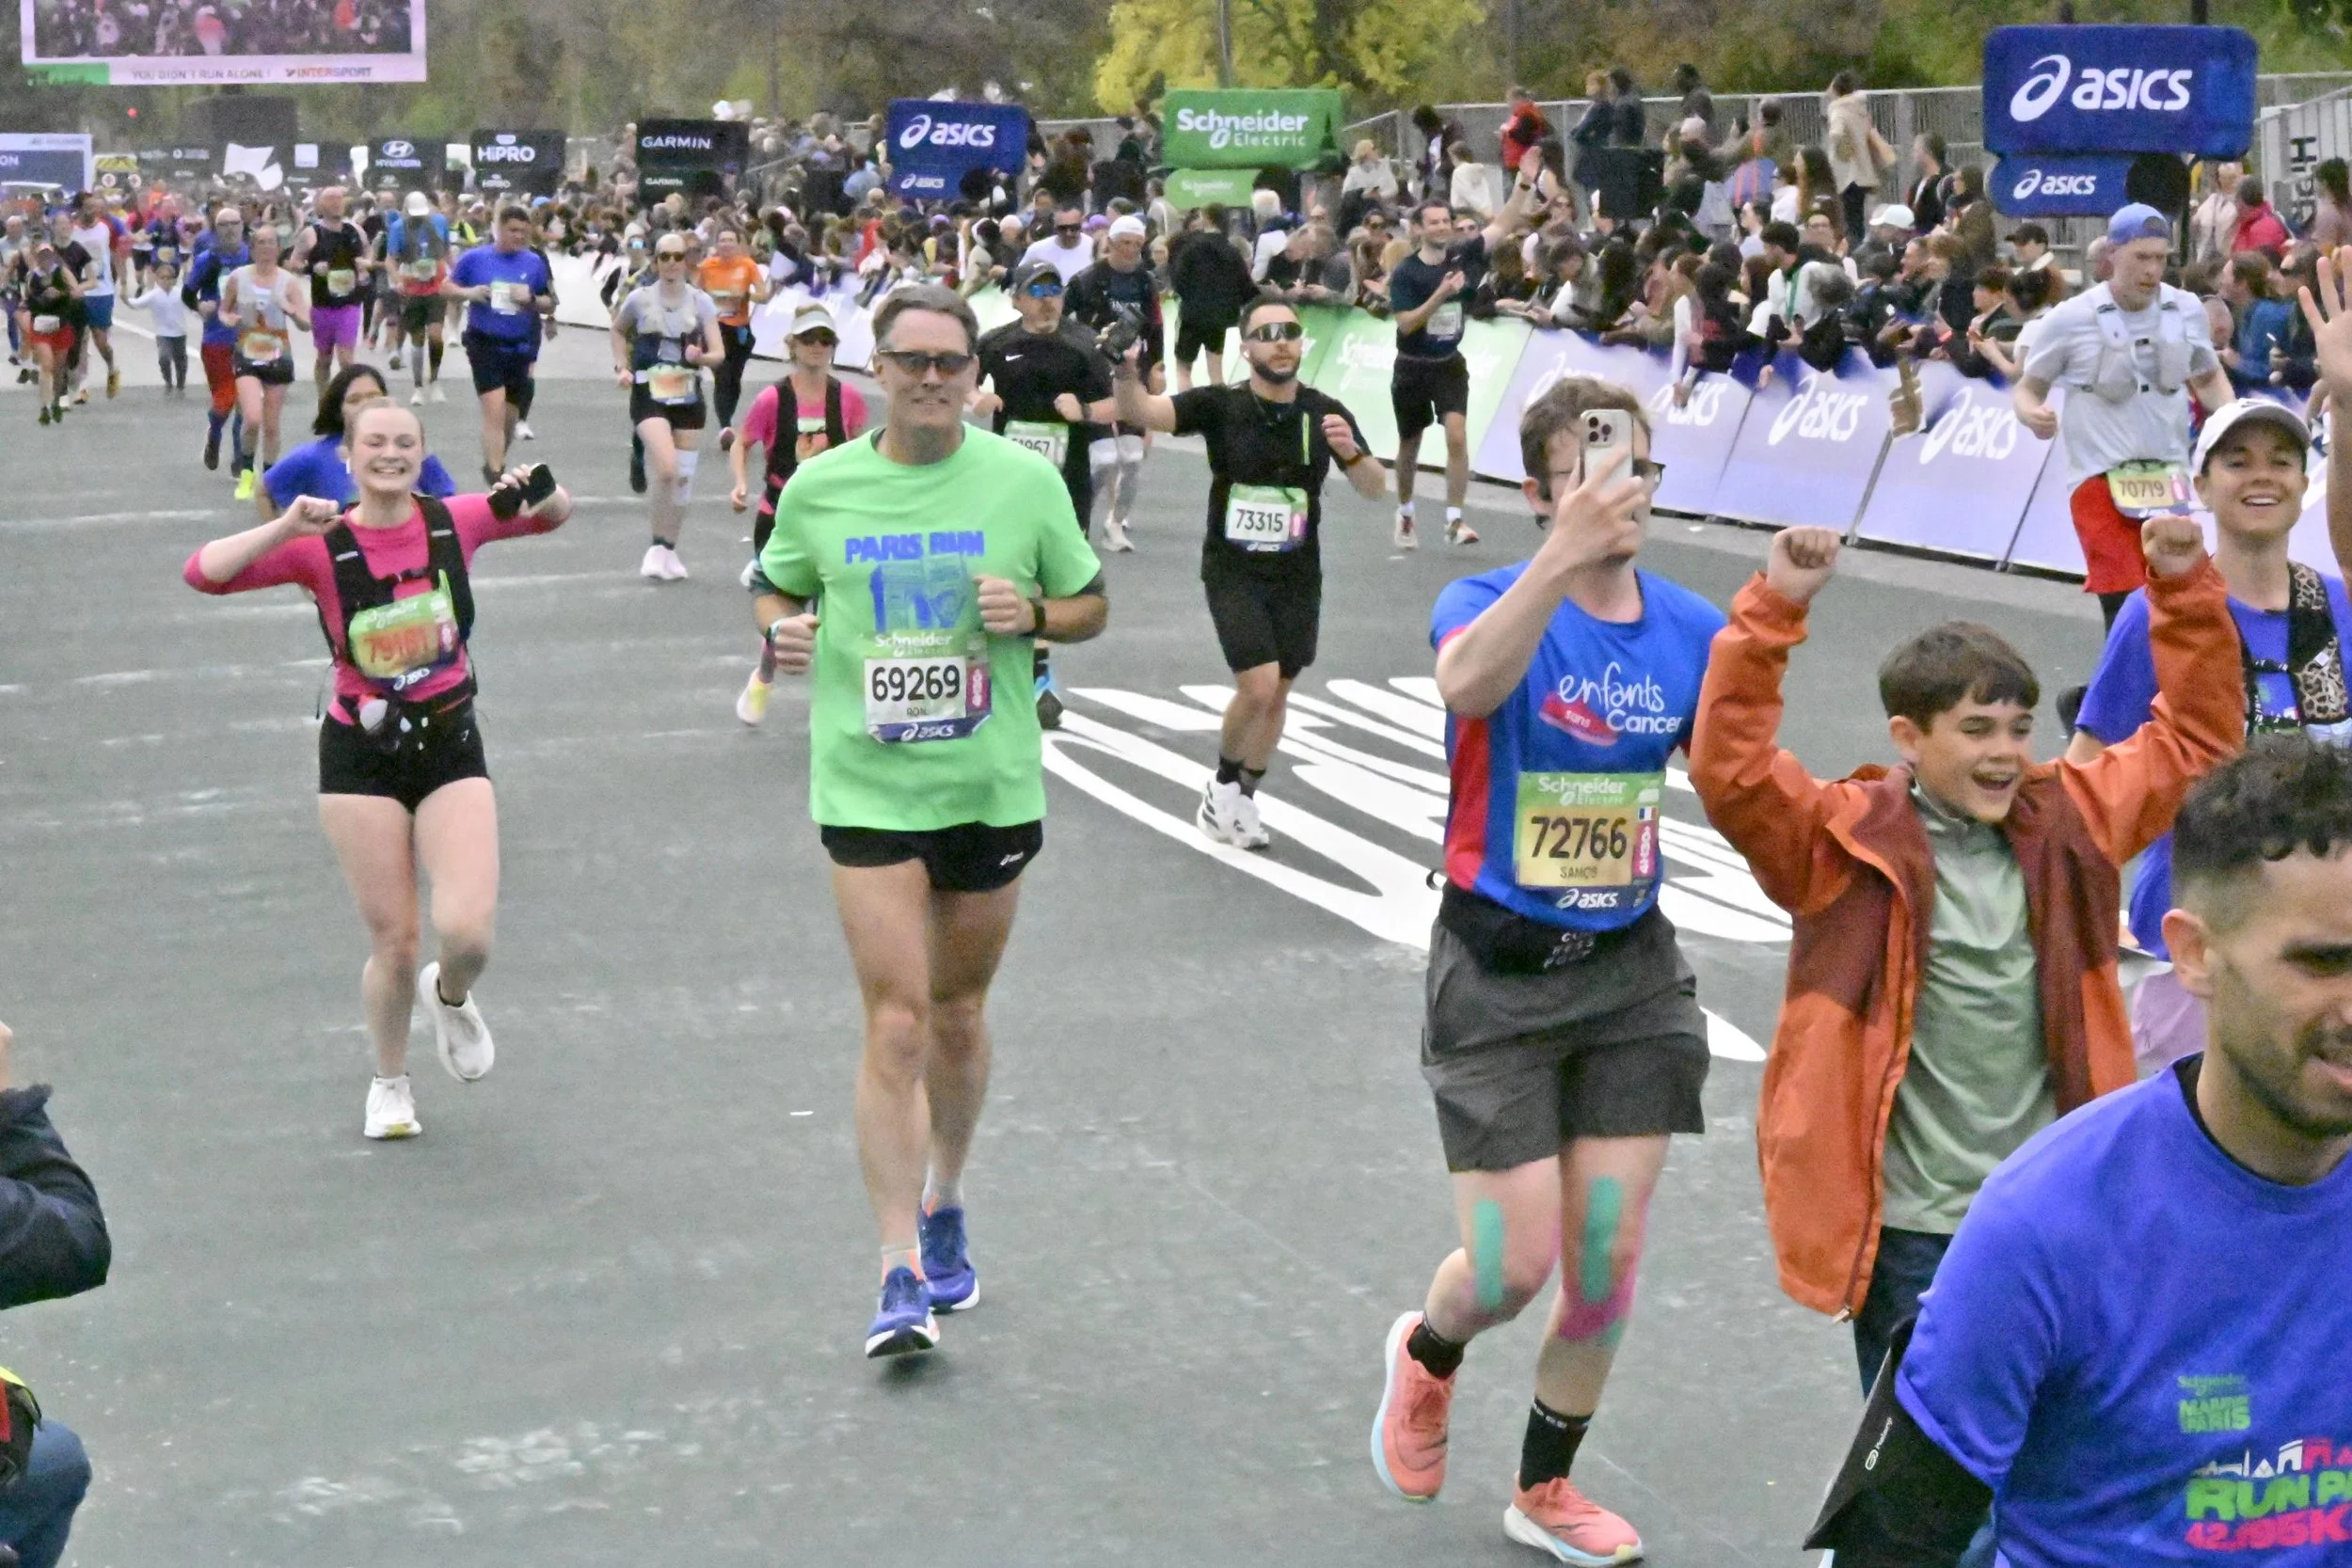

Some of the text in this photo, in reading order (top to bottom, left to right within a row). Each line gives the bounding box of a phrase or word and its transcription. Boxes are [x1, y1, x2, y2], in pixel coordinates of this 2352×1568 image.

[296, 67, 372, 78] INTERSPORT
[2071, 68, 2193, 111] asics
[1177, 108, 1309, 132] Schneider
[642, 135, 712, 150] GARMIN
[930, 122, 996, 147] asics
[1233, 132, 1307, 147] Electric
[2041, 175, 2097, 195] asics
[1798, 390, 1869, 442] asics
[1952, 405, 2017, 460] asics
[2119, 480, 2165, 498] 70719
[1236, 508, 1284, 533] 73315
[845, 533, 924, 564] PARIS
[875, 631, 953, 647] Schneider
[872, 664, 961, 702] 69269
[1559, 661, 1665, 713] enfants
[917, 724, 955, 738] asics
[1565, 709, 1592, 729] sans
[1606, 708, 1683, 734] Cancer
[1538, 776, 1627, 794] Schneider
[1531, 816, 1628, 860] 72766
[1578, 892, 1619, 909] asics
[2185, 1474, 2311, 1521] RUN
